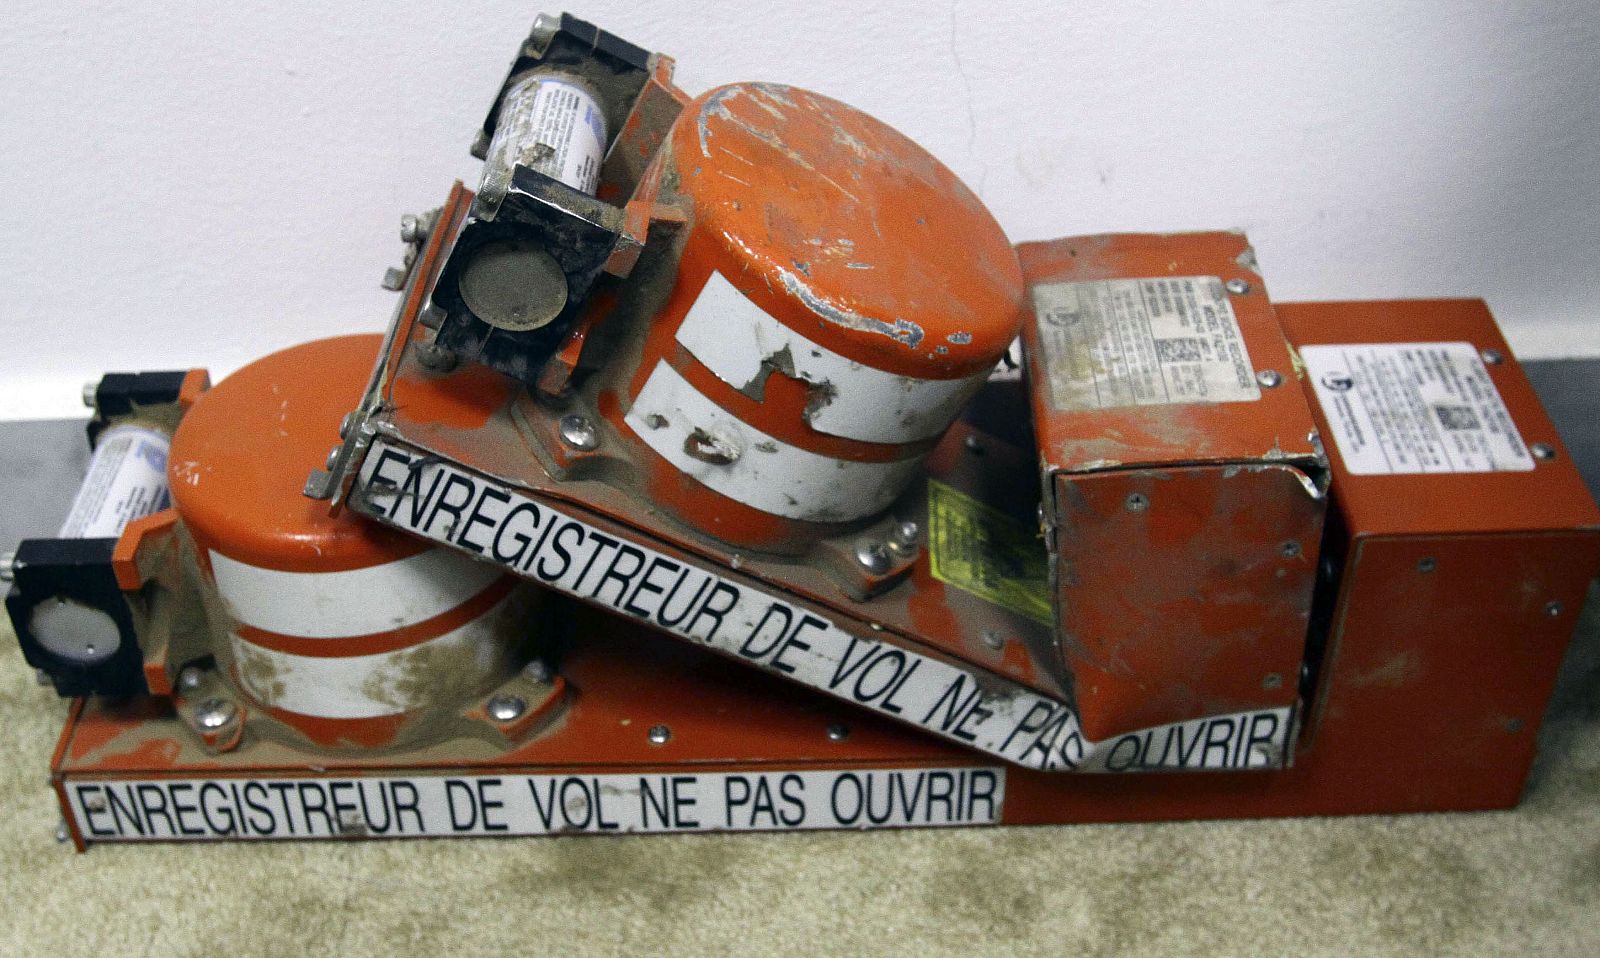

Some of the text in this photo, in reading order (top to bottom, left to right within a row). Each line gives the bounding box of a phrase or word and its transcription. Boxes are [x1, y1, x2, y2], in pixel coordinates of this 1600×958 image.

[361, 448, 1279, 770] ENREGISTREUR DE VOL NE PAS OUVRIR
[76, 770, 999, 837] ENREGISTREUR DE VOL NE PAS OUVRIR
